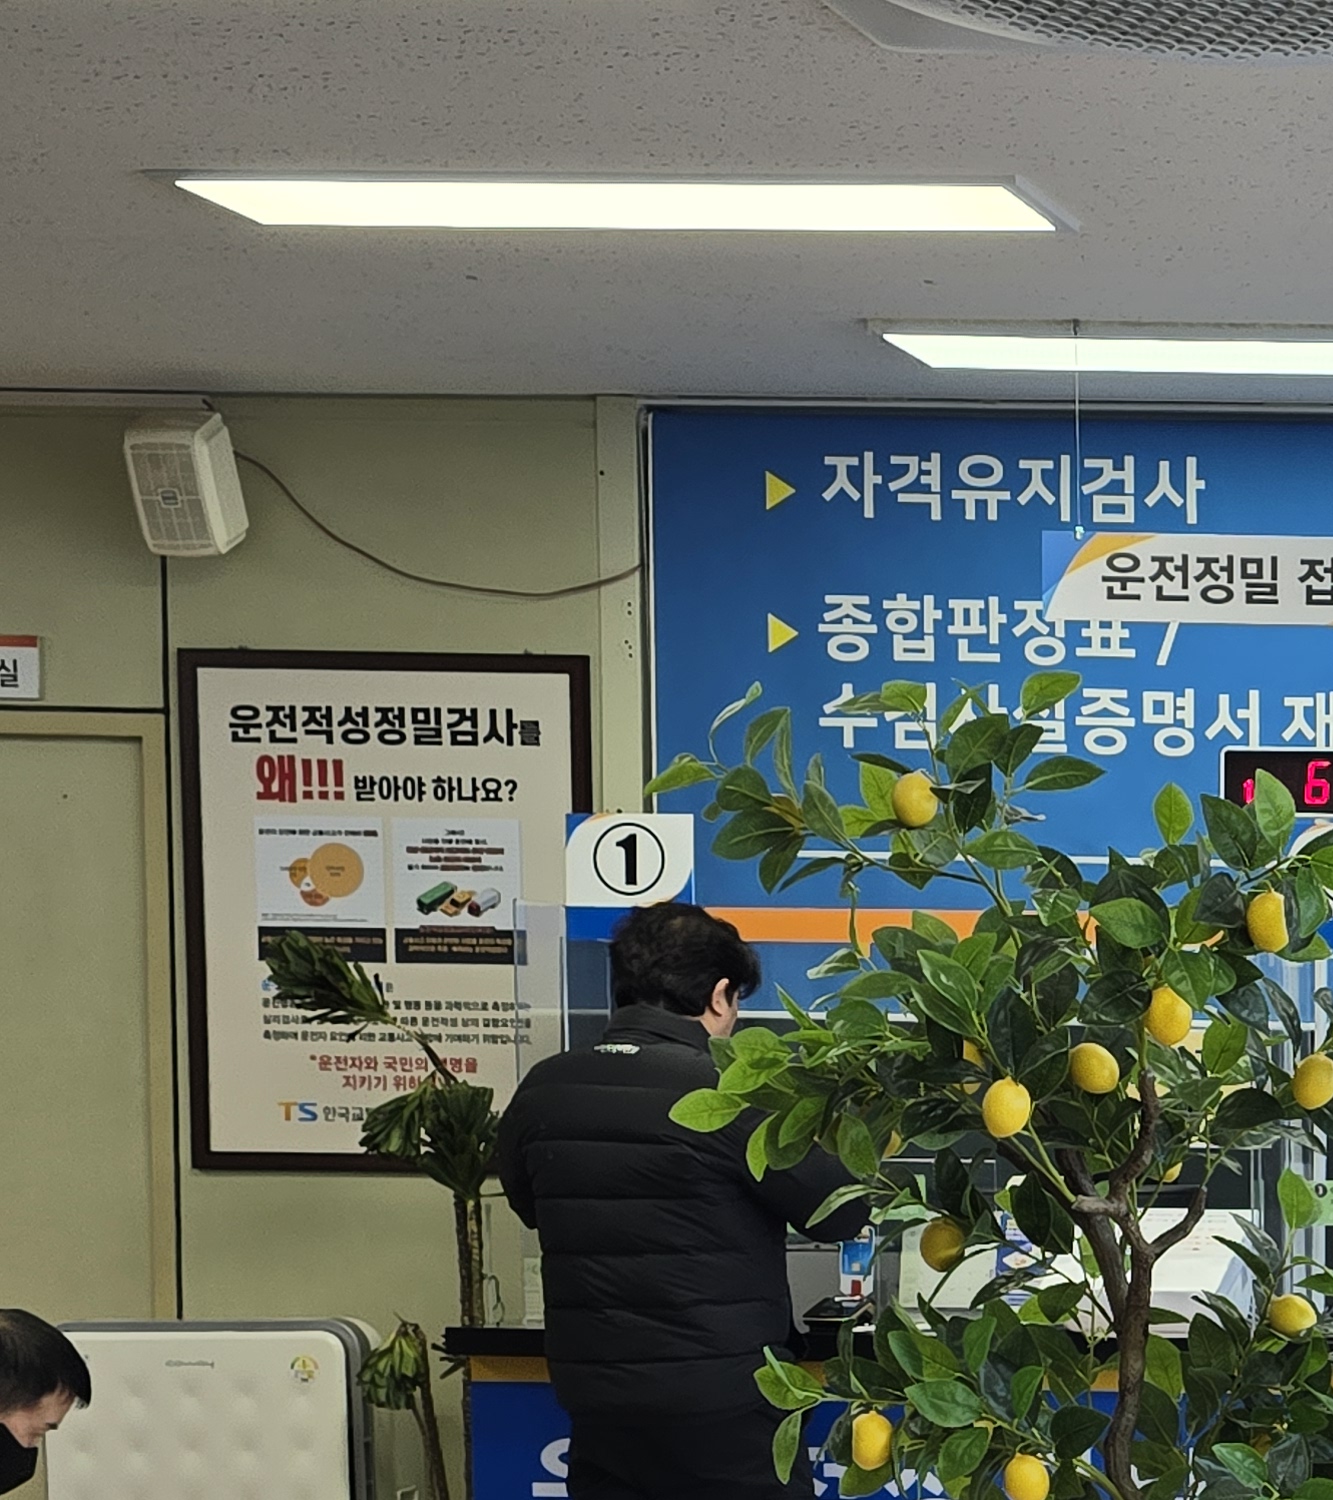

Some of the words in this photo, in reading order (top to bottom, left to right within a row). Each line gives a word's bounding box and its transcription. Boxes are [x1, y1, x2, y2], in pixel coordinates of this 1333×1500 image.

[821, 453, 1205, 525] 자격유지검사
[1102, 551, 1278, 604] 운전정밀
[0, 659, 19, 688] 실
[228, 704, 541, 747] 운전적성정밀검사를
[256, 754, 345, 803] 왜!!!
[354, 775, 426, 803] 받아야
[432, 777, 518, 803] 하나요?
[384, 1056, 429, 1073] 국민의
[342, 1076, 388, 1092] 지키기
[278, 1101, 318, 1122] TS
